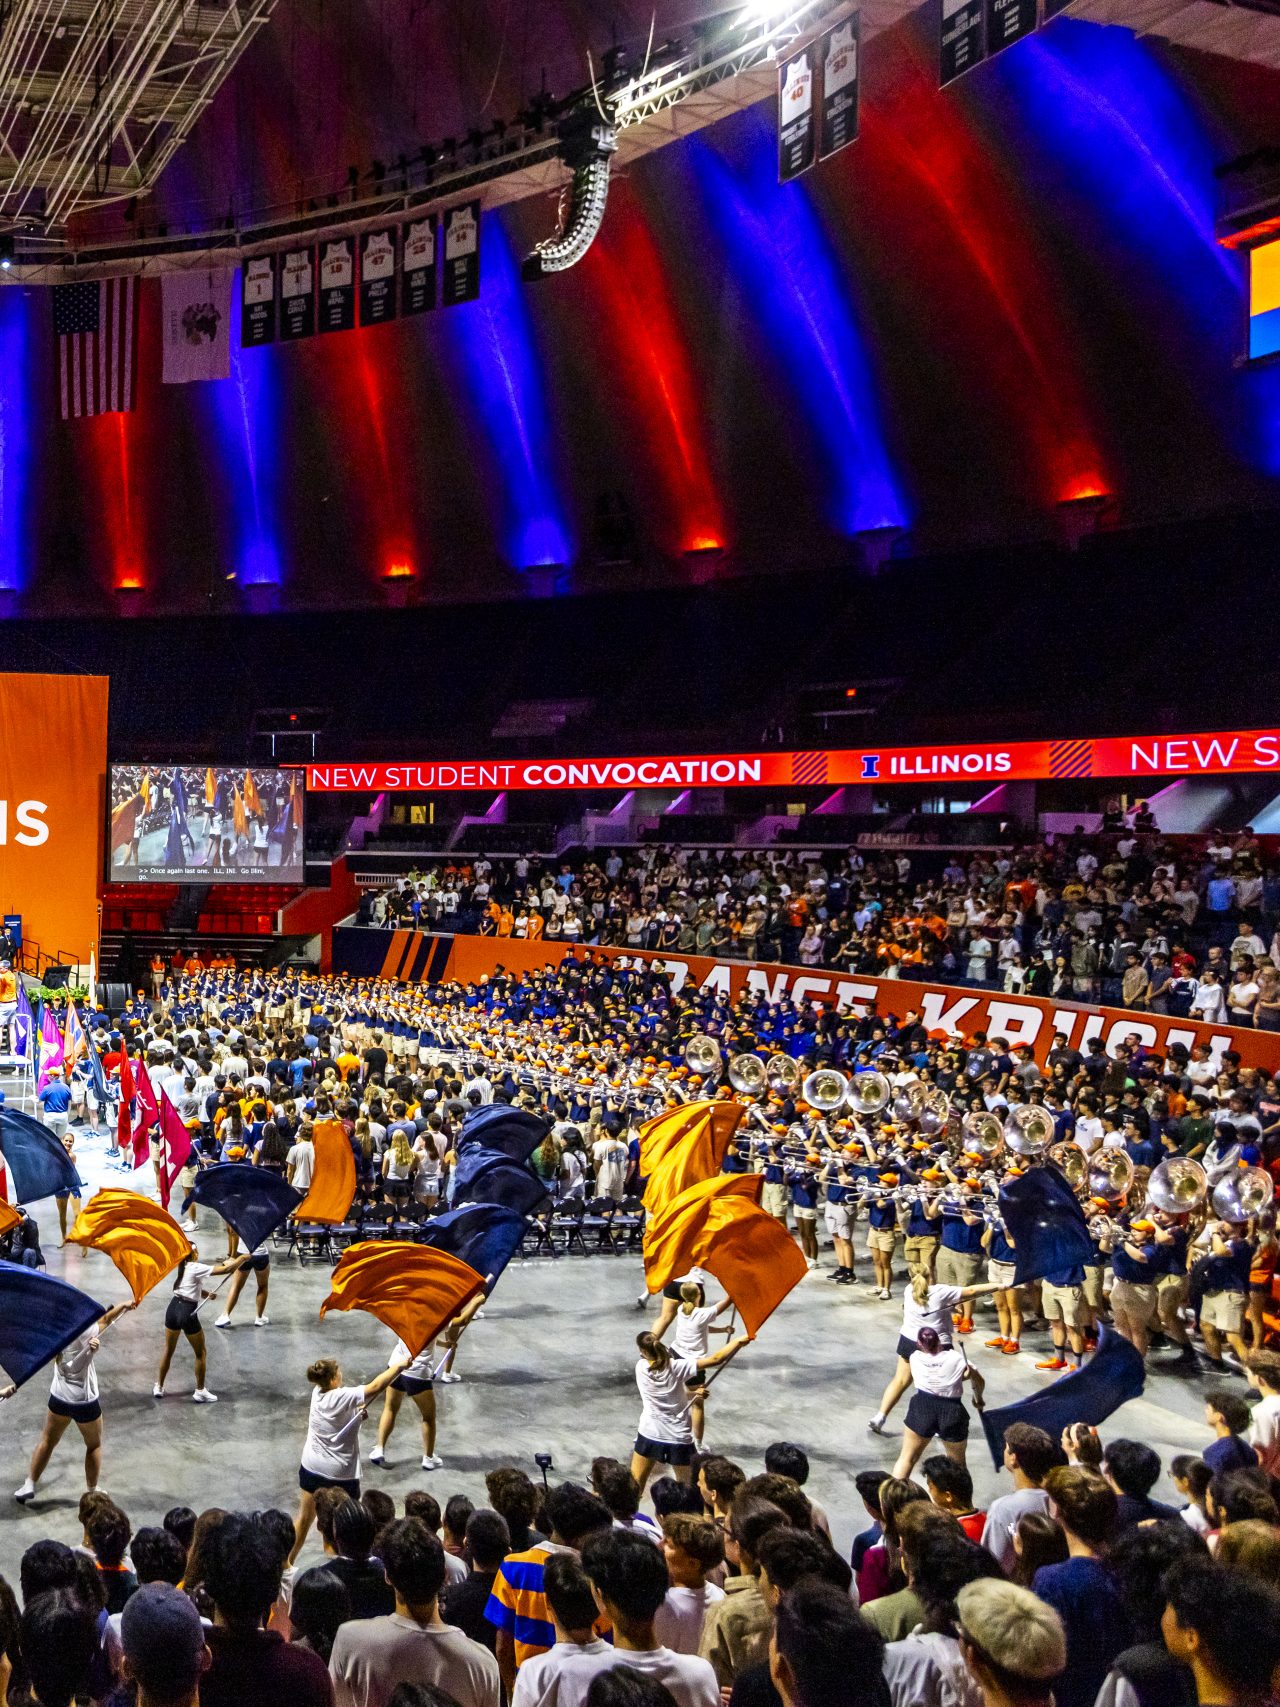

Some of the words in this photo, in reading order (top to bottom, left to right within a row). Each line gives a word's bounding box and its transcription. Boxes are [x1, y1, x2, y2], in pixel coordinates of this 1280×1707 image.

[790, 86, 804, 101] 40
[371, 255, 385, 265] 47
[257, 284, 262, 295] 1
[860, 755, 881, 778] I
[890, 752, 1011, 775] ILLINOIS
[1131, 738, 1239, 770] NEW
[1253, 736, 1279, 766] S
[312, 767, 377, 788] NEW
[384, 765, 516, 786] STUDENT
[522, 759, 761, 785] CONVOCATION
[619, 955, 878, 1018] RANGE
